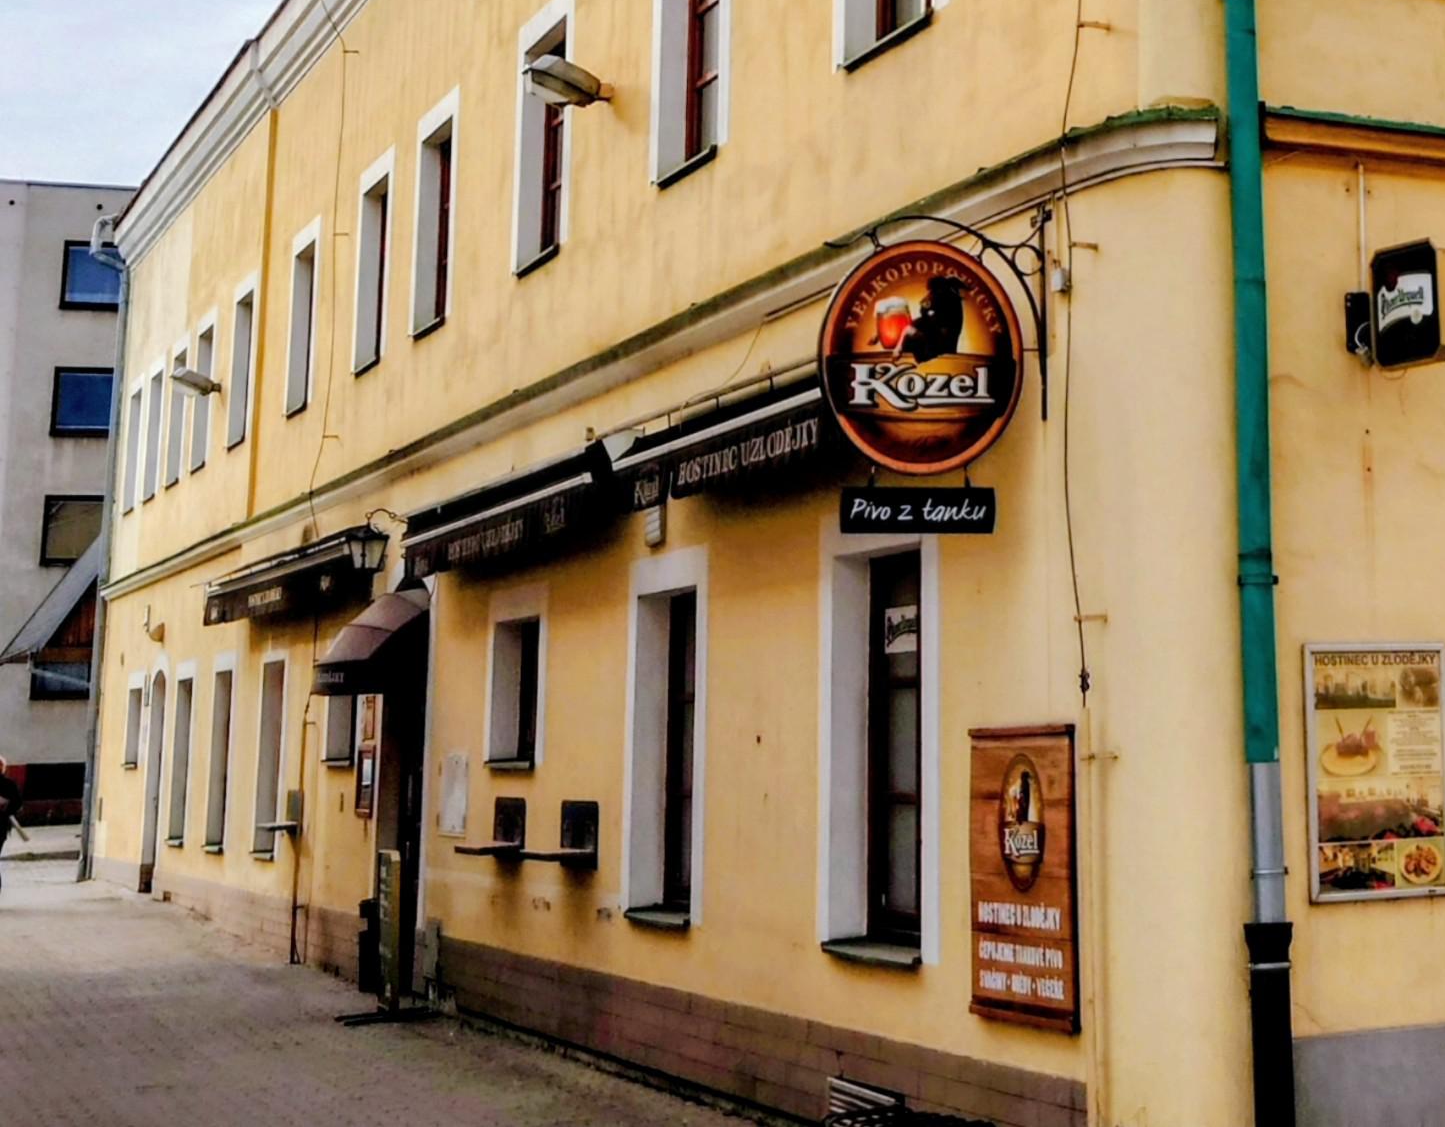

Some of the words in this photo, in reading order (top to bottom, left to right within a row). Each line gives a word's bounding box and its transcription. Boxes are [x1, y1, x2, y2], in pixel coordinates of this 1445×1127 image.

[848, 363, 995, 410] Kozel
[850, 498, 891, 521] Pivo
[897, 504, 914, 521] z
[922, 498, 987, 522] tanku
[1314, 654, 1371, 666] HOSTINEC
[1371, 654, 1380, 666] U
[1003, 828, 1040, 856] Kozel
